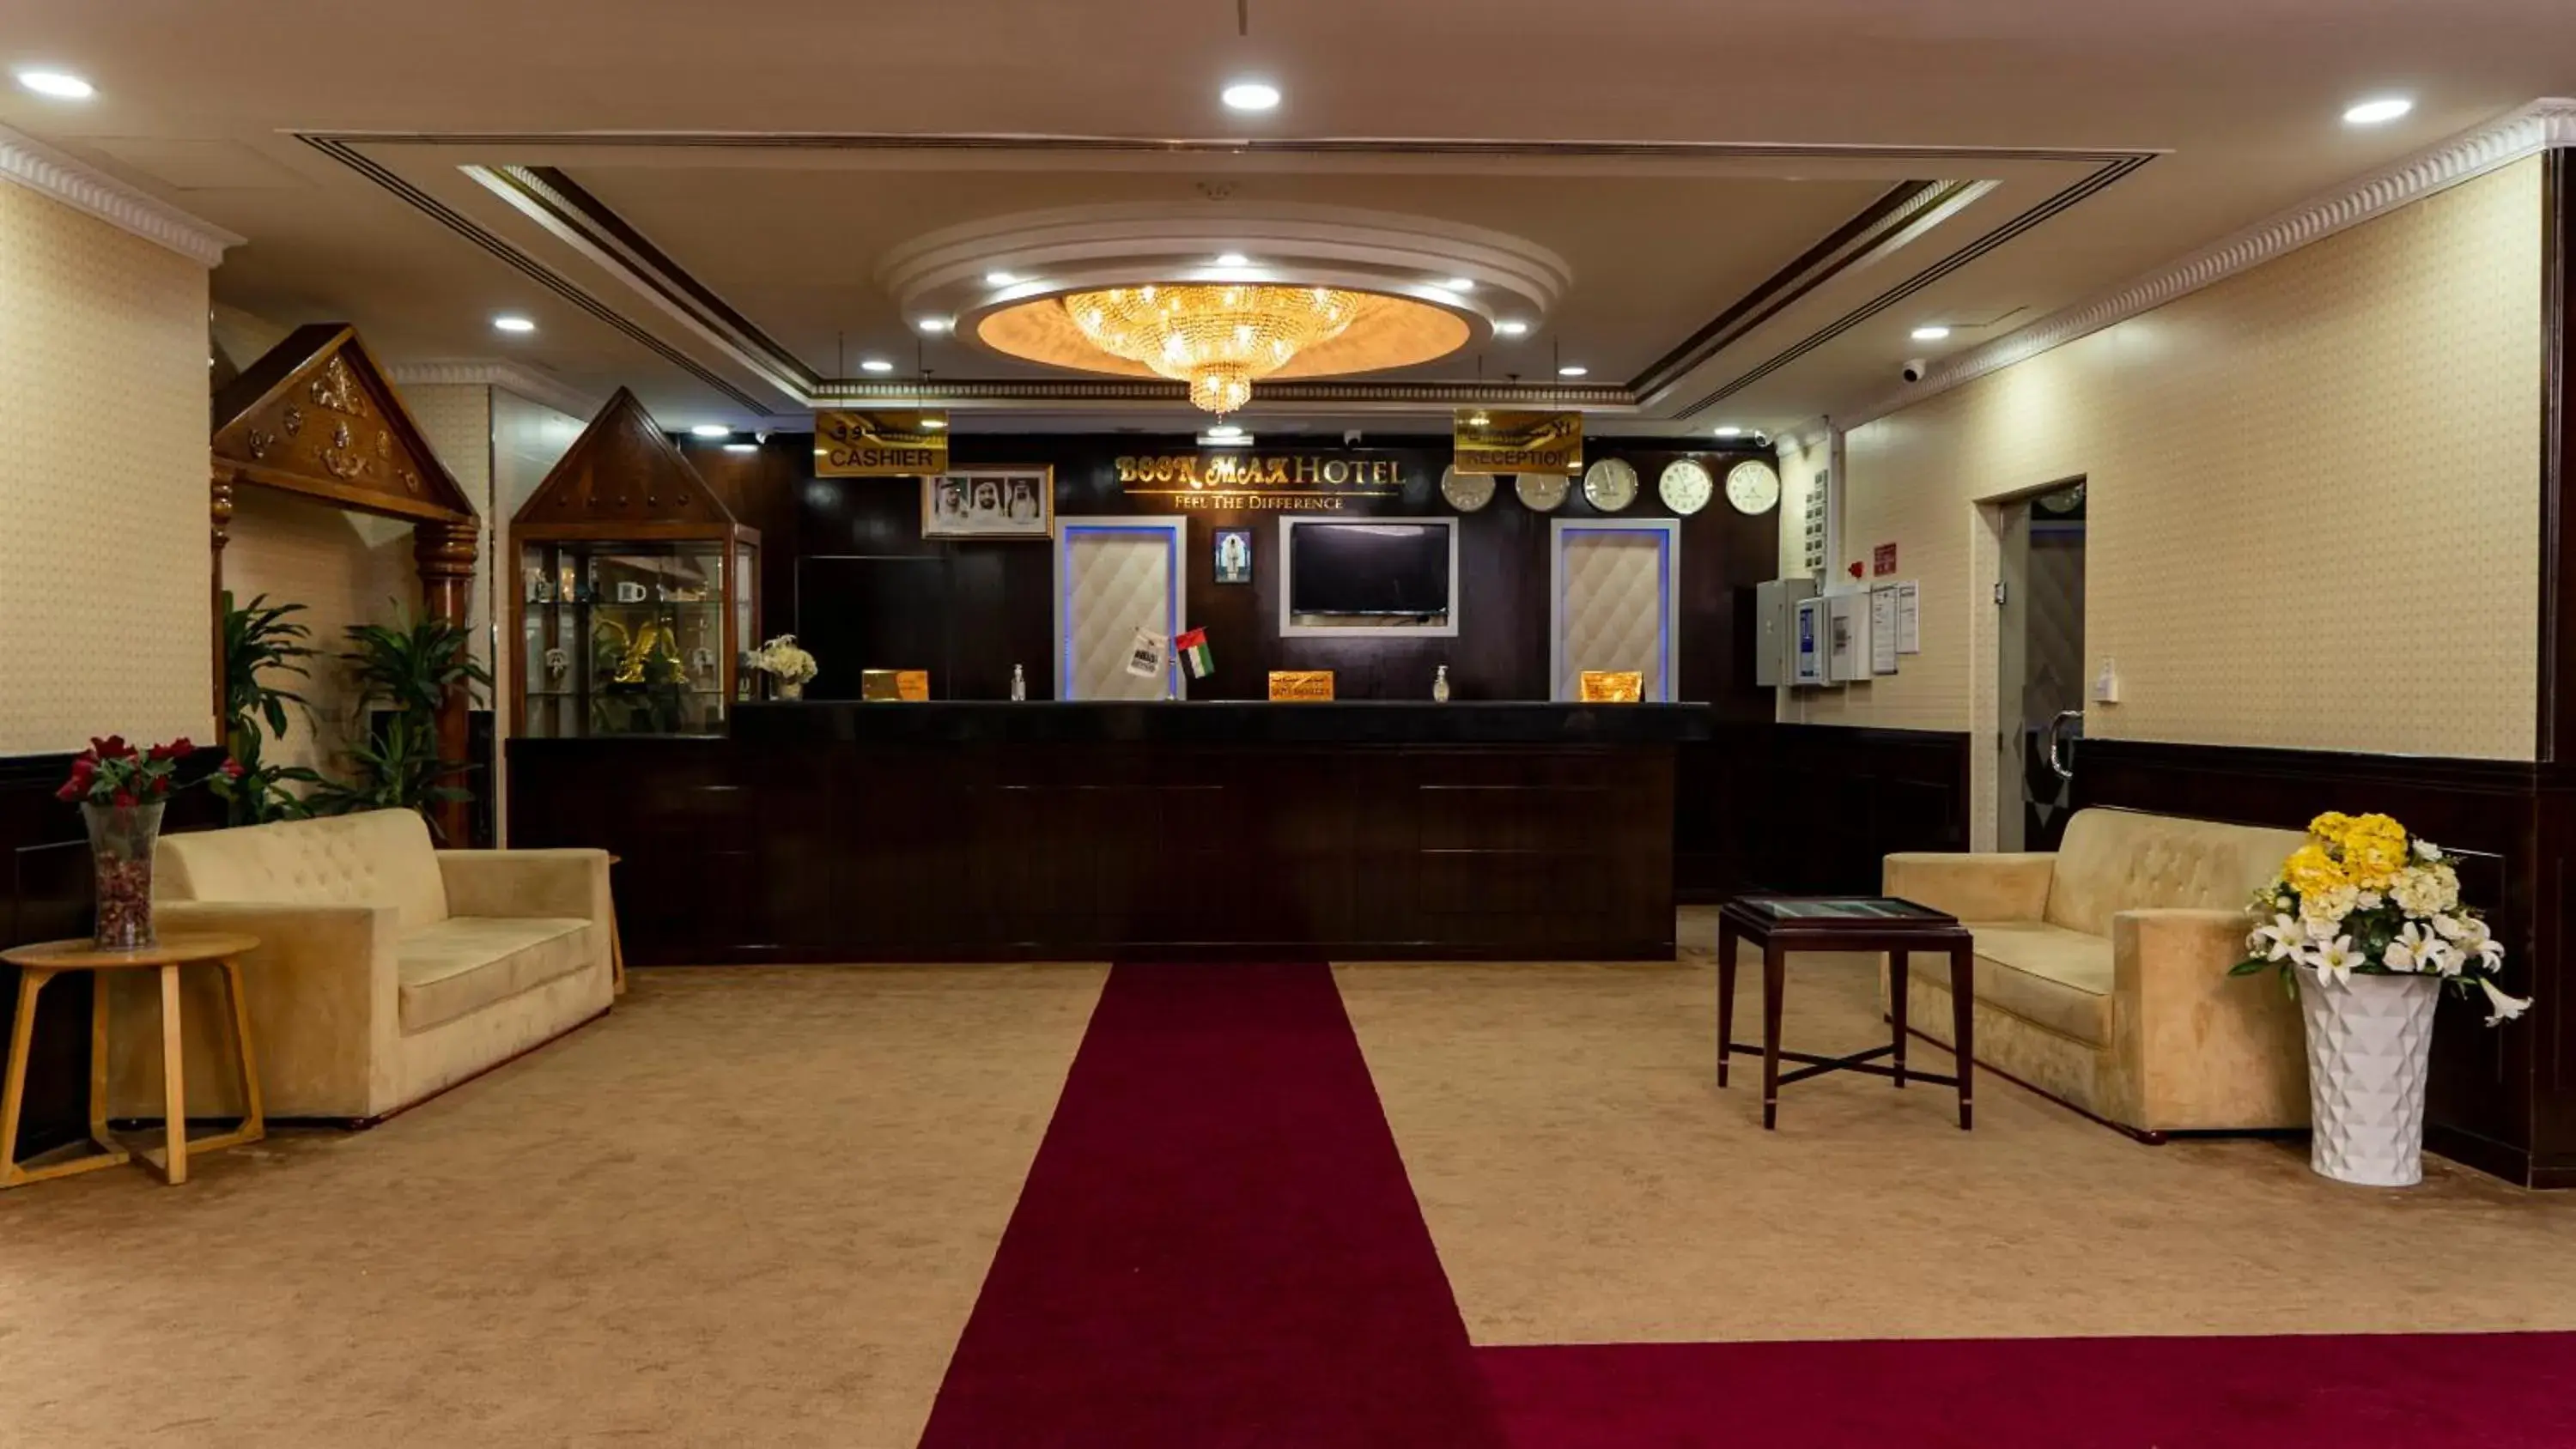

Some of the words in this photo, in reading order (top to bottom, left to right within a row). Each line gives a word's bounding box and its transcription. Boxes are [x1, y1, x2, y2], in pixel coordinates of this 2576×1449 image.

[829, 449, 933, 467] CASHIER
[1469, 451, 1571, 465] RECEPTION
[1205, 455, 1289, 487] MAX
[1293, 456, 1407, 484] HOTEL
[1175, 495, 1207, 509] FEEL
[1212, 495, 1244, 509] THE
[1249, 496, 1344, 510] DIFFERENCE
